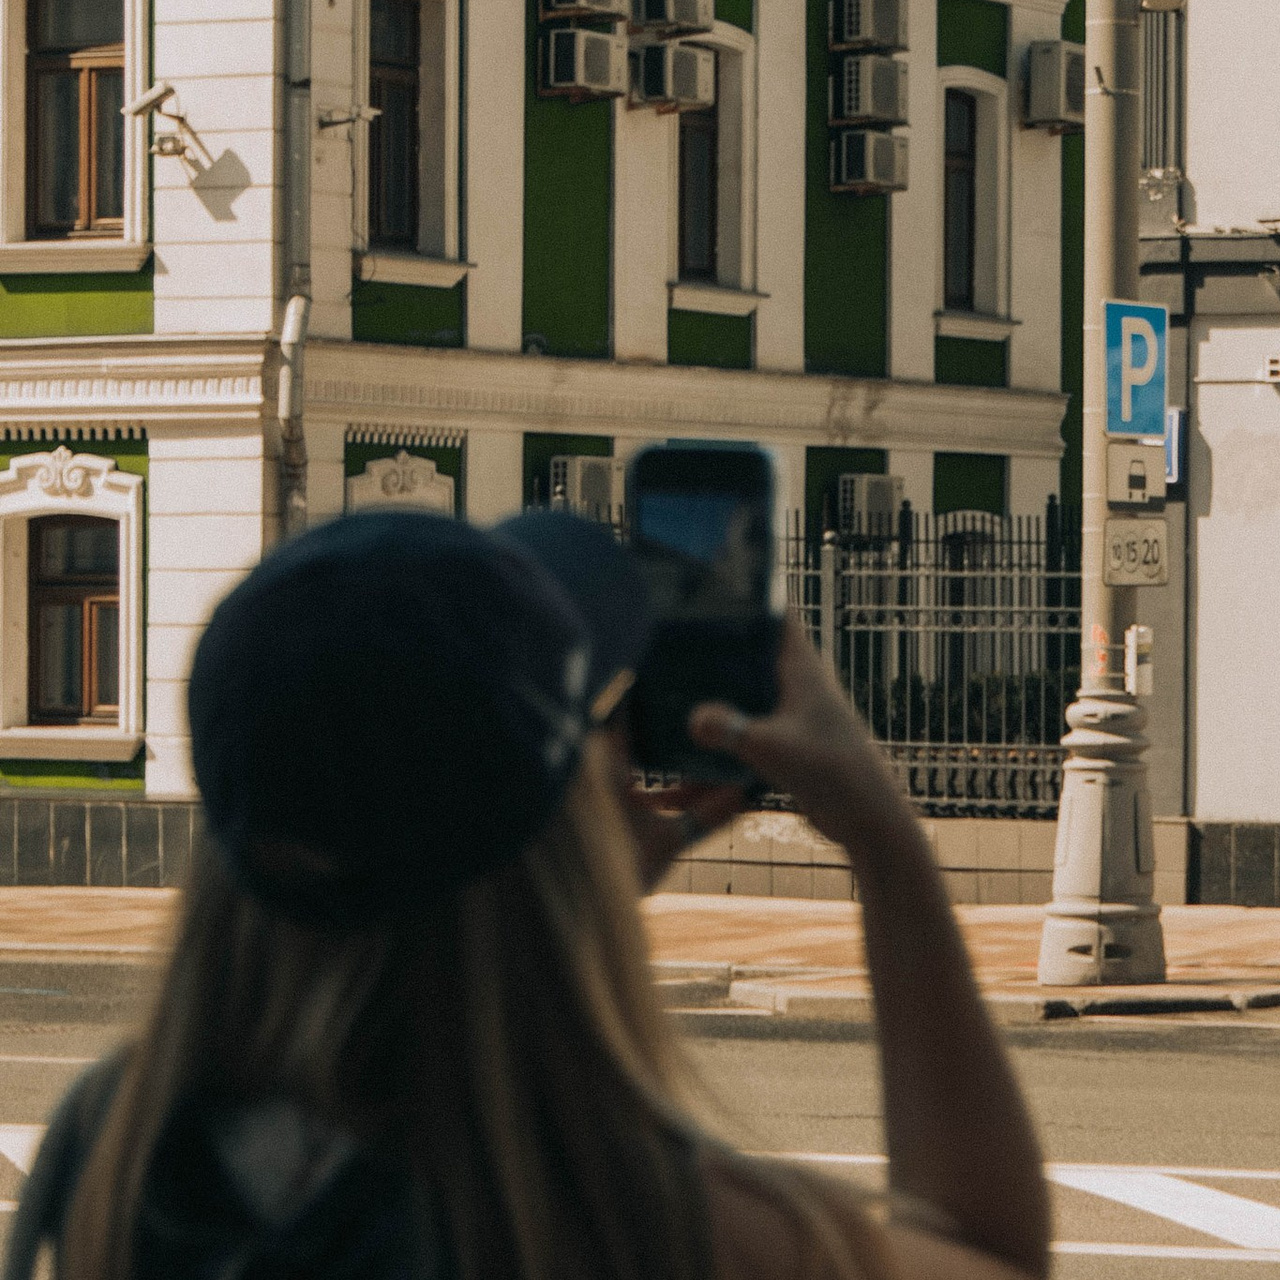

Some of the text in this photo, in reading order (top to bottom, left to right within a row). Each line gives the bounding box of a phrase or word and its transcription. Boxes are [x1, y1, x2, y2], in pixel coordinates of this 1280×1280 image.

[1121, 316, 1158, 422] P
[1125, 541, 1138, 563] 15
[1142, 538, 1161, 566] 20
